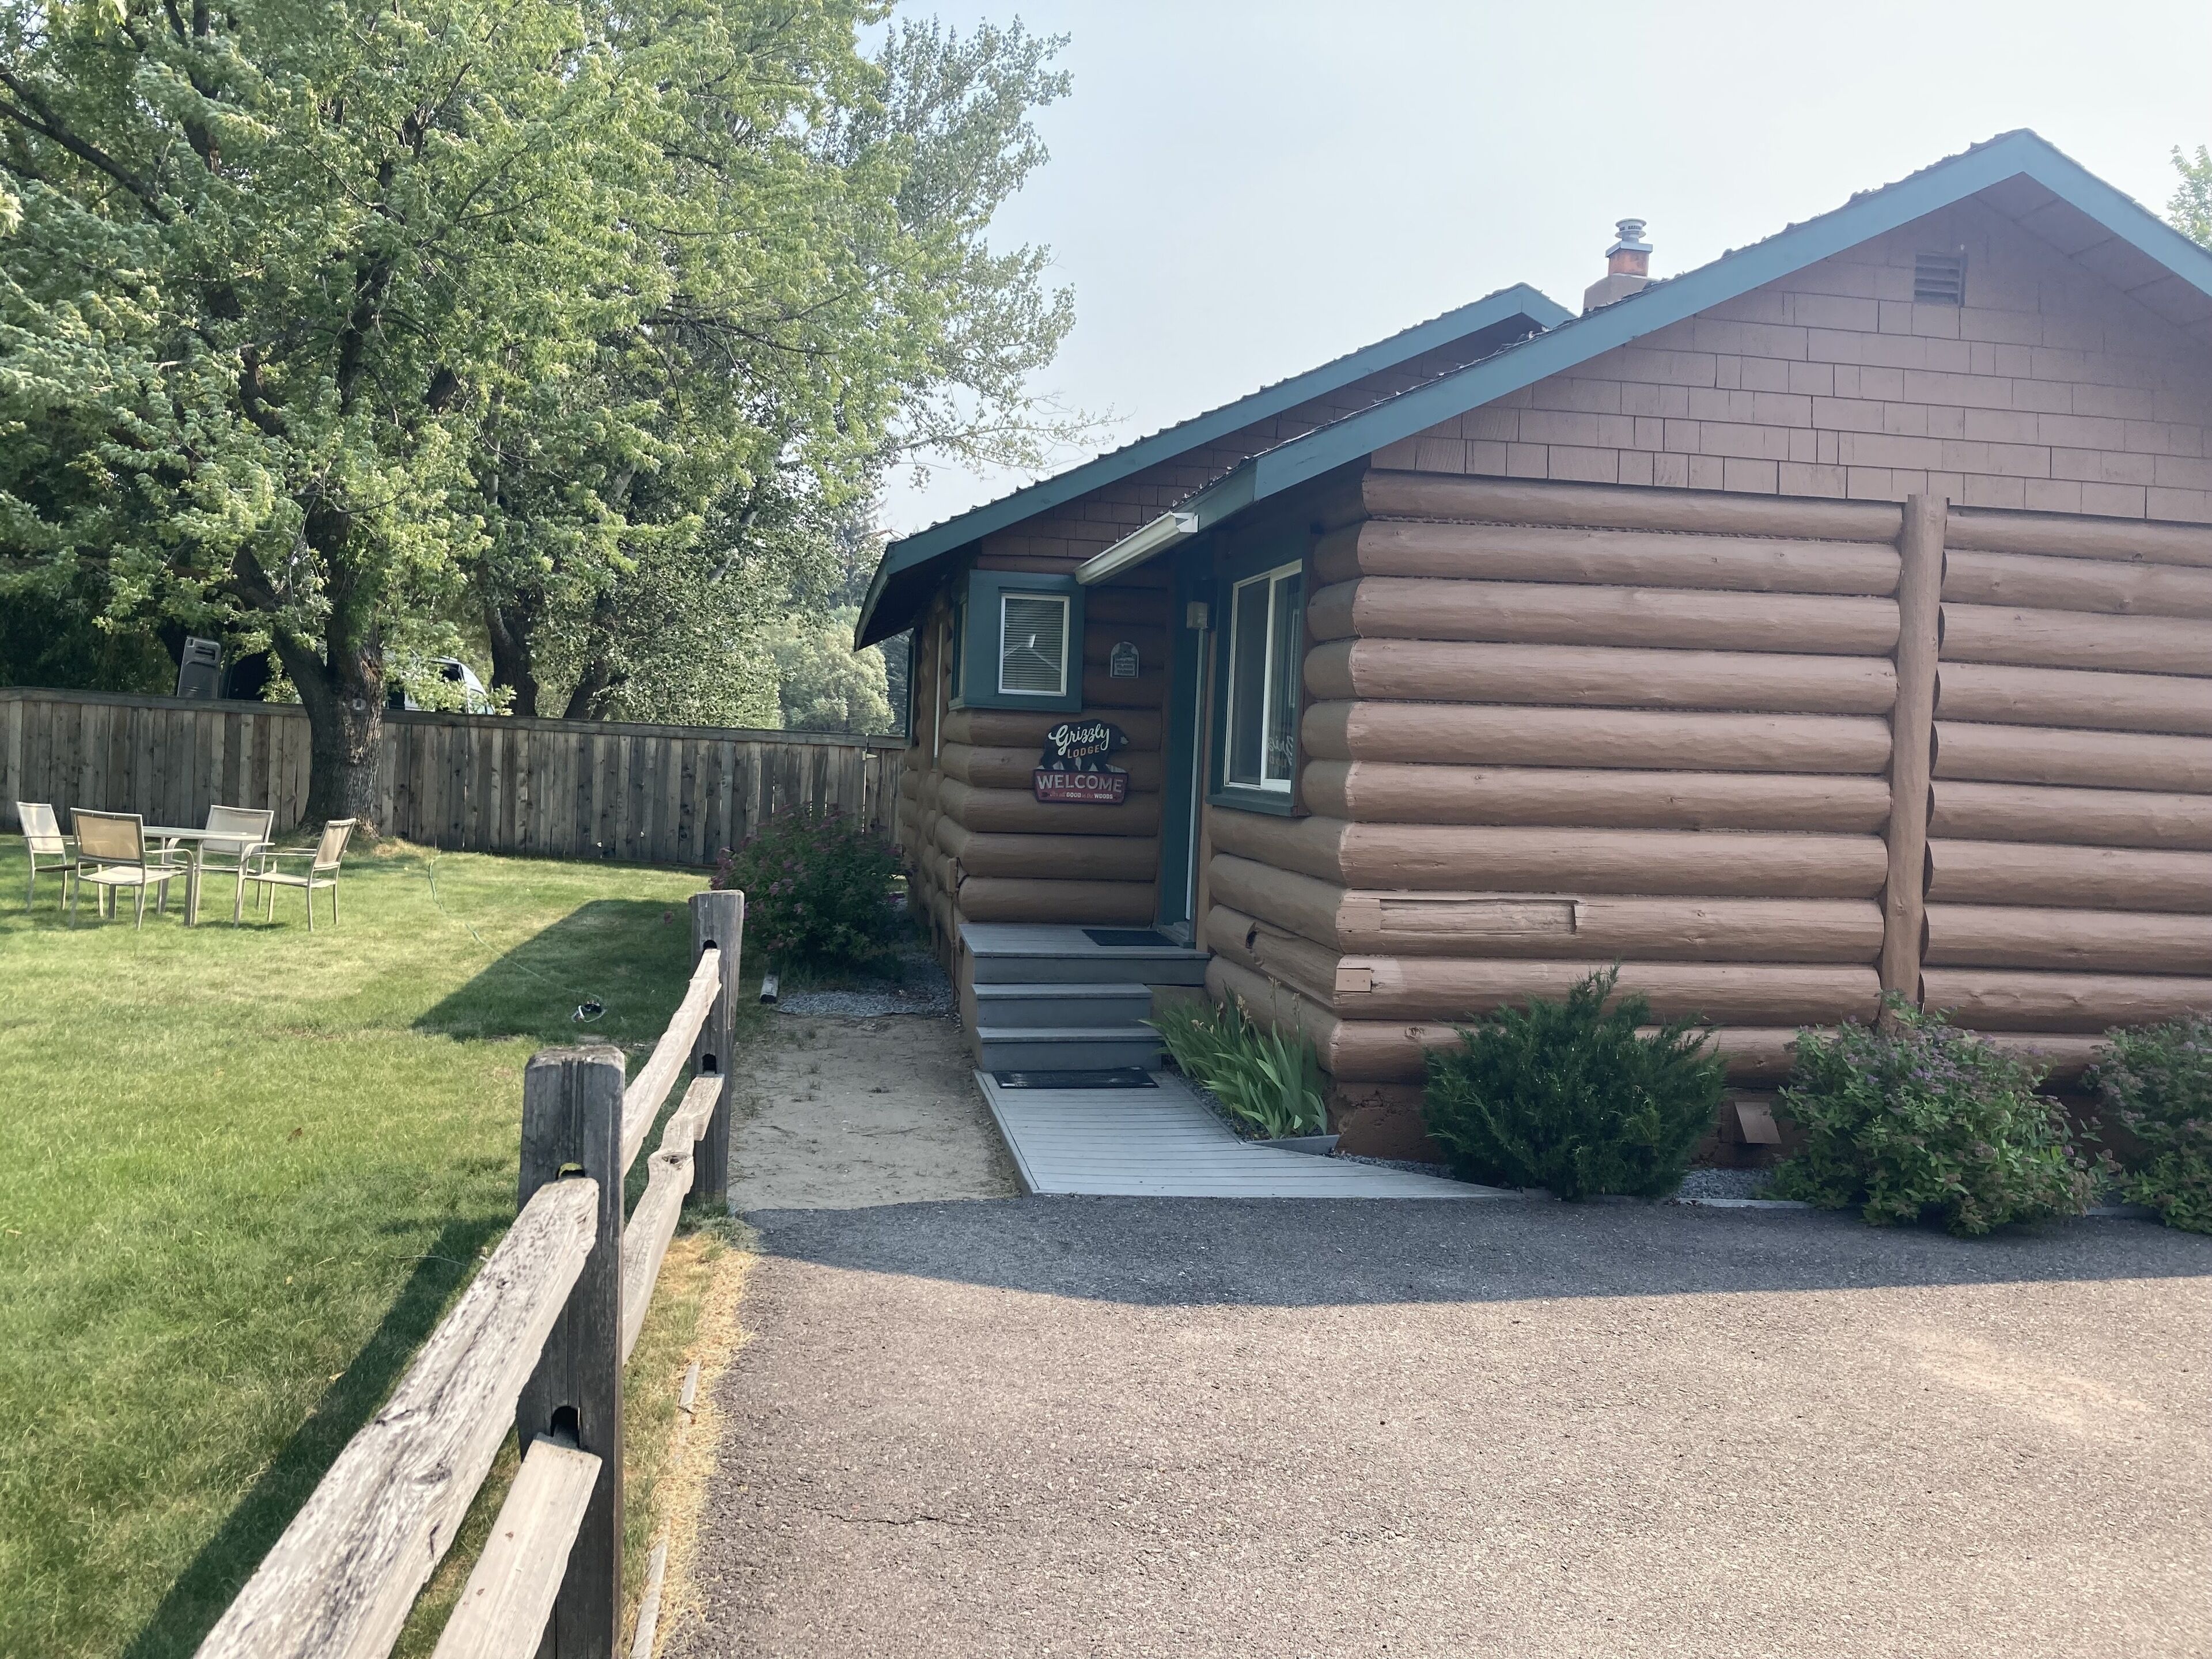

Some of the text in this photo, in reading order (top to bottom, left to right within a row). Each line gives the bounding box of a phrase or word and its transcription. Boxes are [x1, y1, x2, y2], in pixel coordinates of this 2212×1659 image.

[1048, 723, 1110, 756] Grizzly
[1067, 744, 1101, 759] LODGE
[1037, 774, 1123, 793] WELCOME
